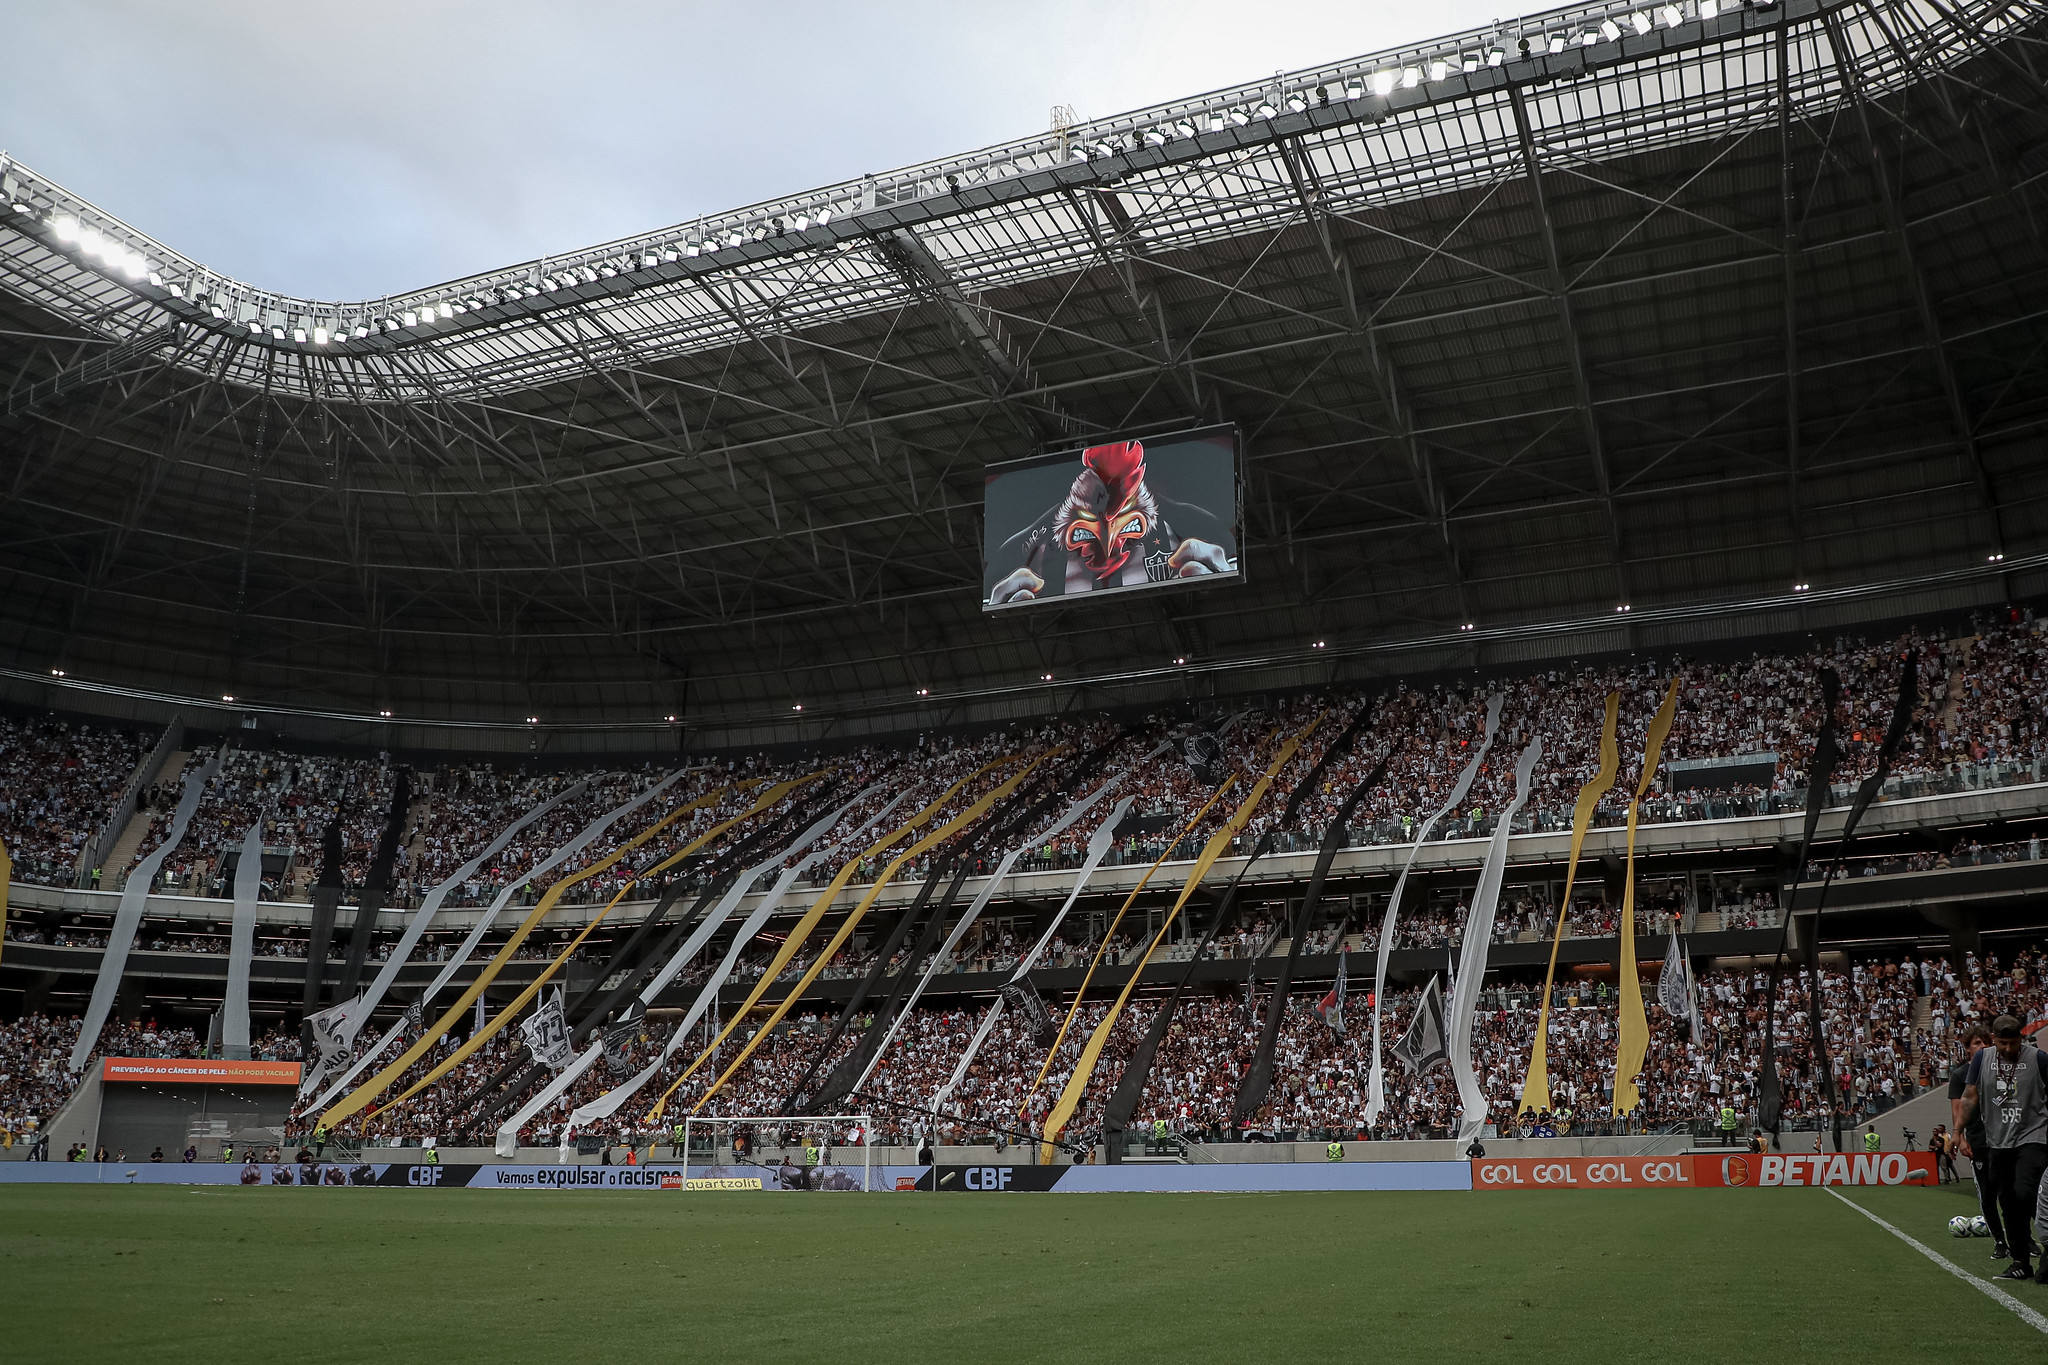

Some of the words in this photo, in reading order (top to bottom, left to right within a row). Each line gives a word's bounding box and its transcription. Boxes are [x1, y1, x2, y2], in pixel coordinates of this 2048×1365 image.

[111, 1065, 155, 1074] PREVENÇÃO
[168, 1066, 198, 1074] CÂNCER
[229, 1068, 244, 1076] NÃO
[2001, 1107, 2022, 1123] 595
[408, 1166, 443, 1186] CBF
[496, 1170, 535, 1184] Vamos
[537, 1166, 605, 1188] expulsar
[609, 1174, 616, 1185] o
[965, 1168, 1013, 1190] CBF
[1480, 1165, 1524, 1184] GOL
[1532, 1164, 1578, 1184] GOL
[1586, 1163, 1632, 1183] GOL
[1641, 1162, 1689, 1182] GOL
[1759, 1153, 1908, 1186] BETANO
[686, 1179, 758, 1190] quartzolit
